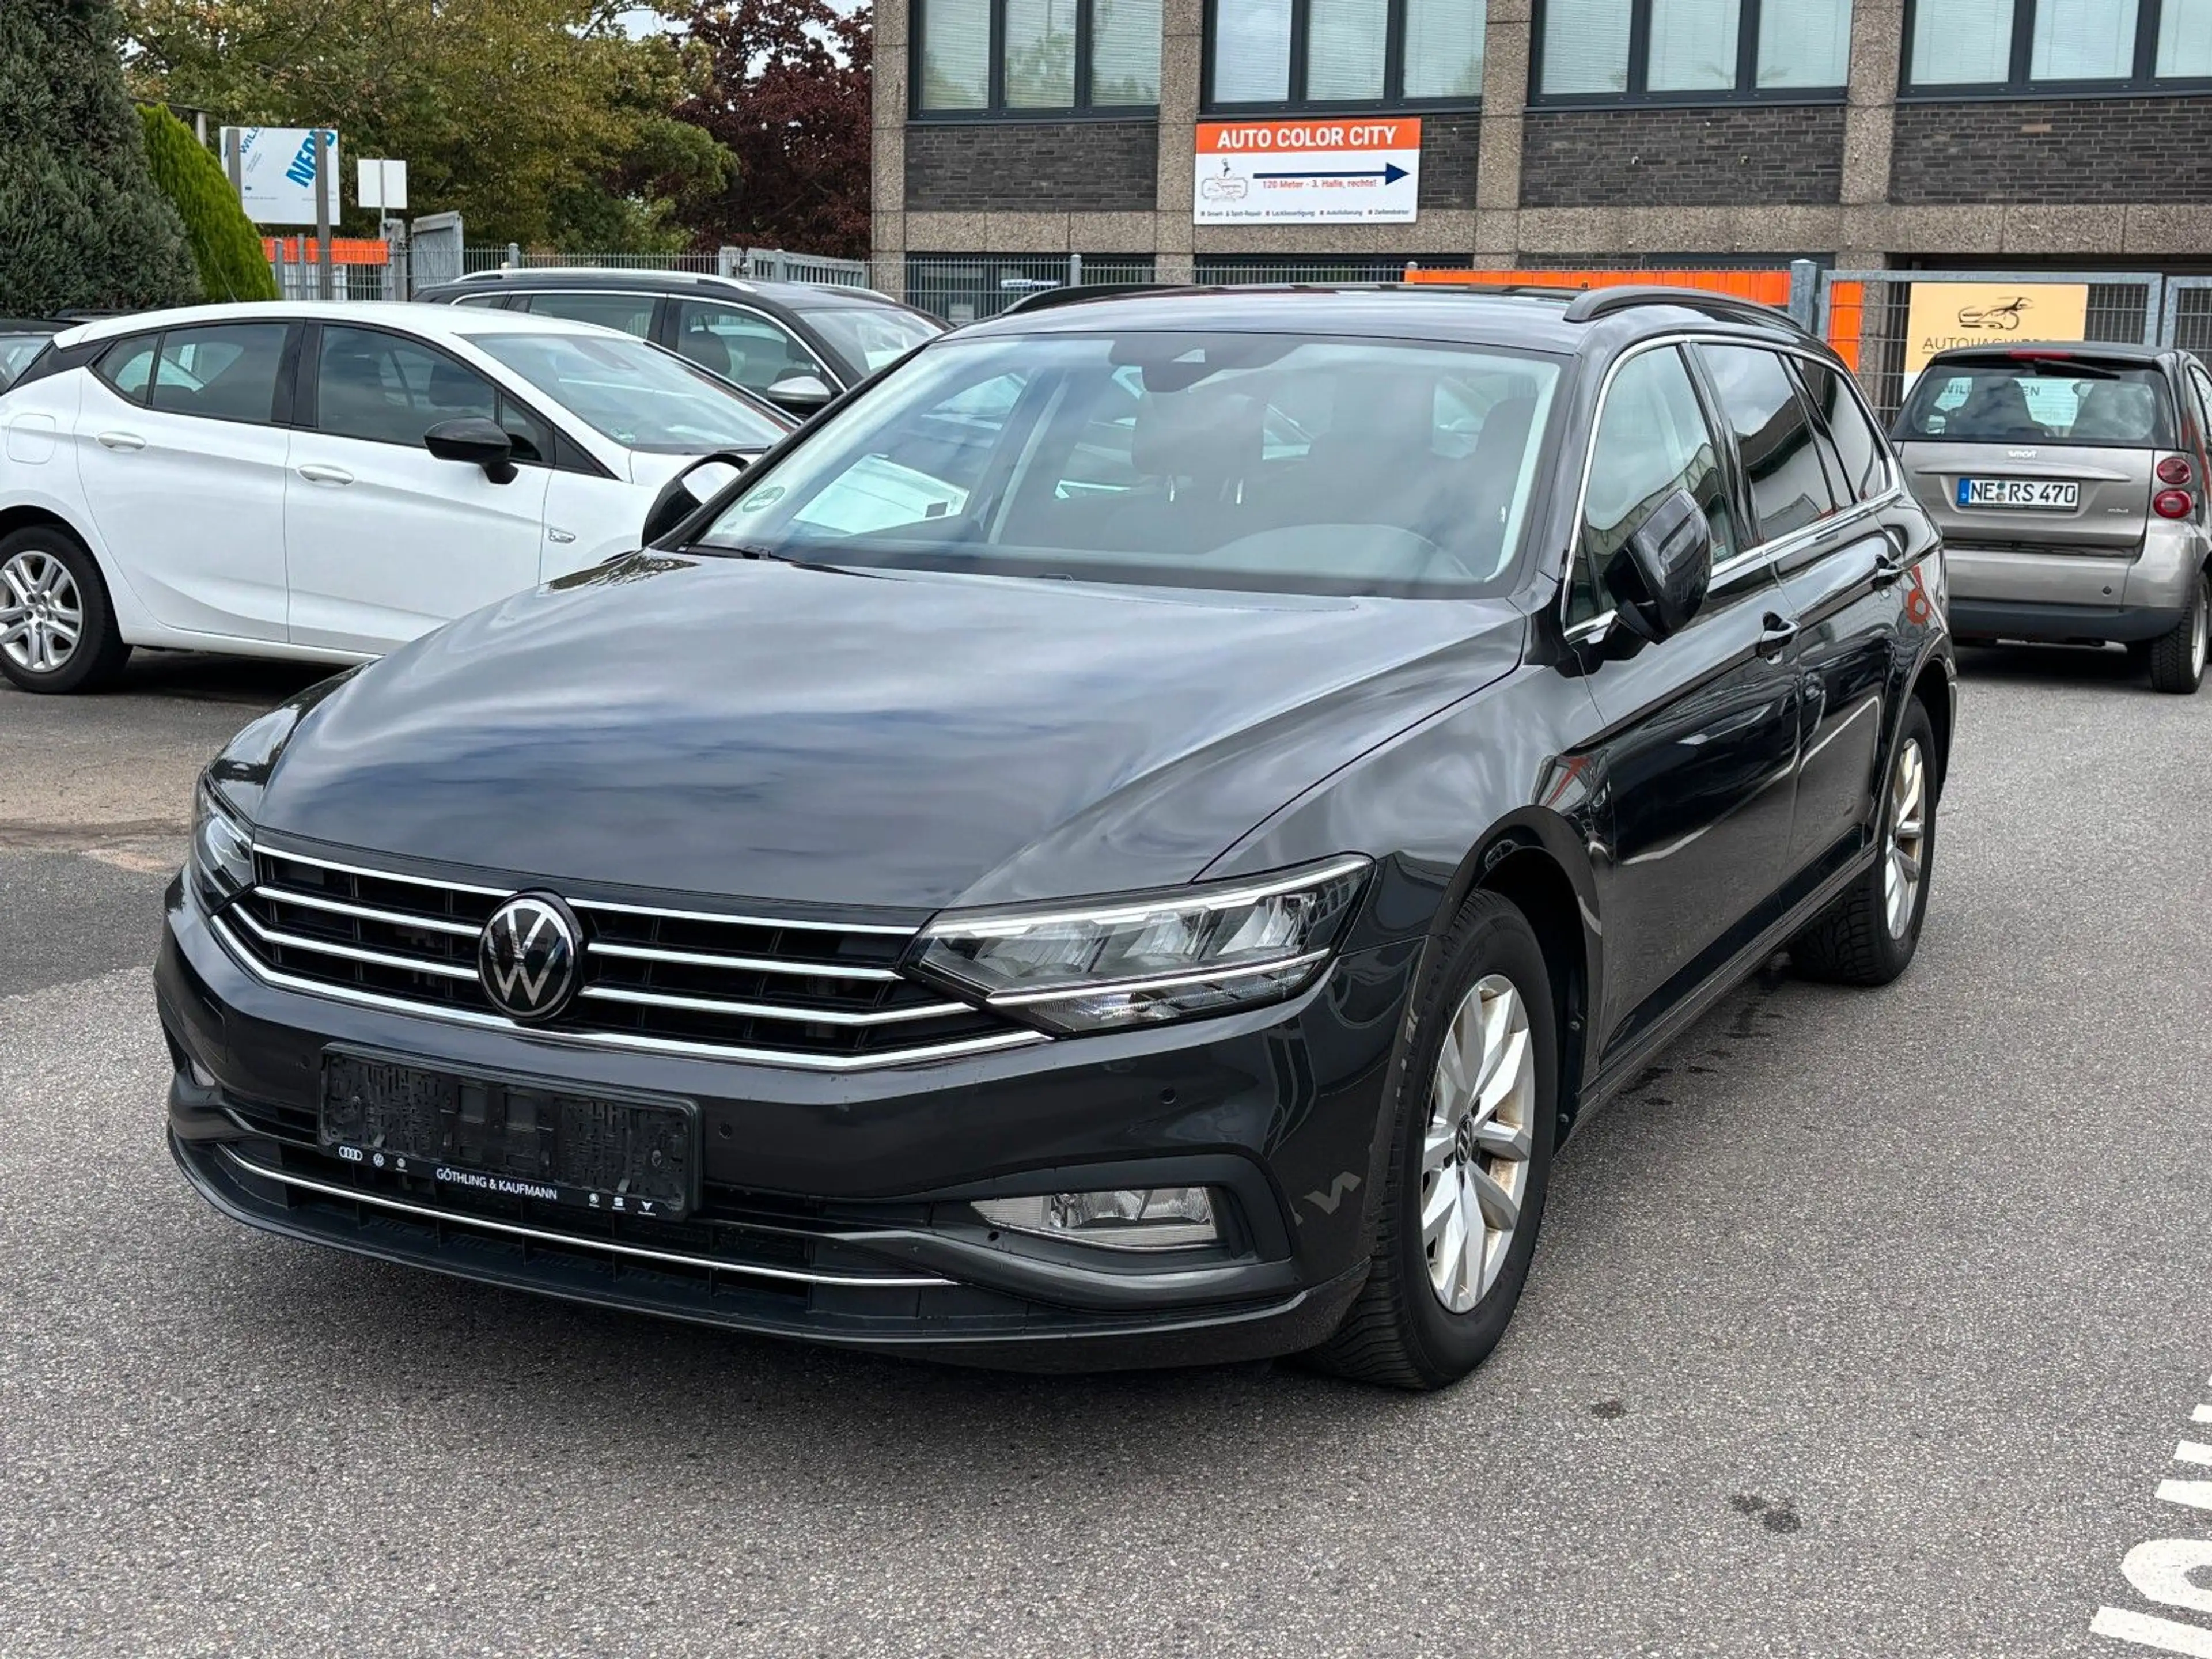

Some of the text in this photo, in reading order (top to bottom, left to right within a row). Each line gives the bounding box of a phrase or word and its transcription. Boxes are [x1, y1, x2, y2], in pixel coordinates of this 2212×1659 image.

[1217, 125, 1397, 149] AUTO COLOR CITY
[1263, 180, 1277, 189] 120
[1280, 180, 1304, 189] Meter
[1971, 482, 2076, 503] NE RS 470
[489, 1177, 497, 1190] &
[499, 1180, 558, 1200] KAUFMANN
